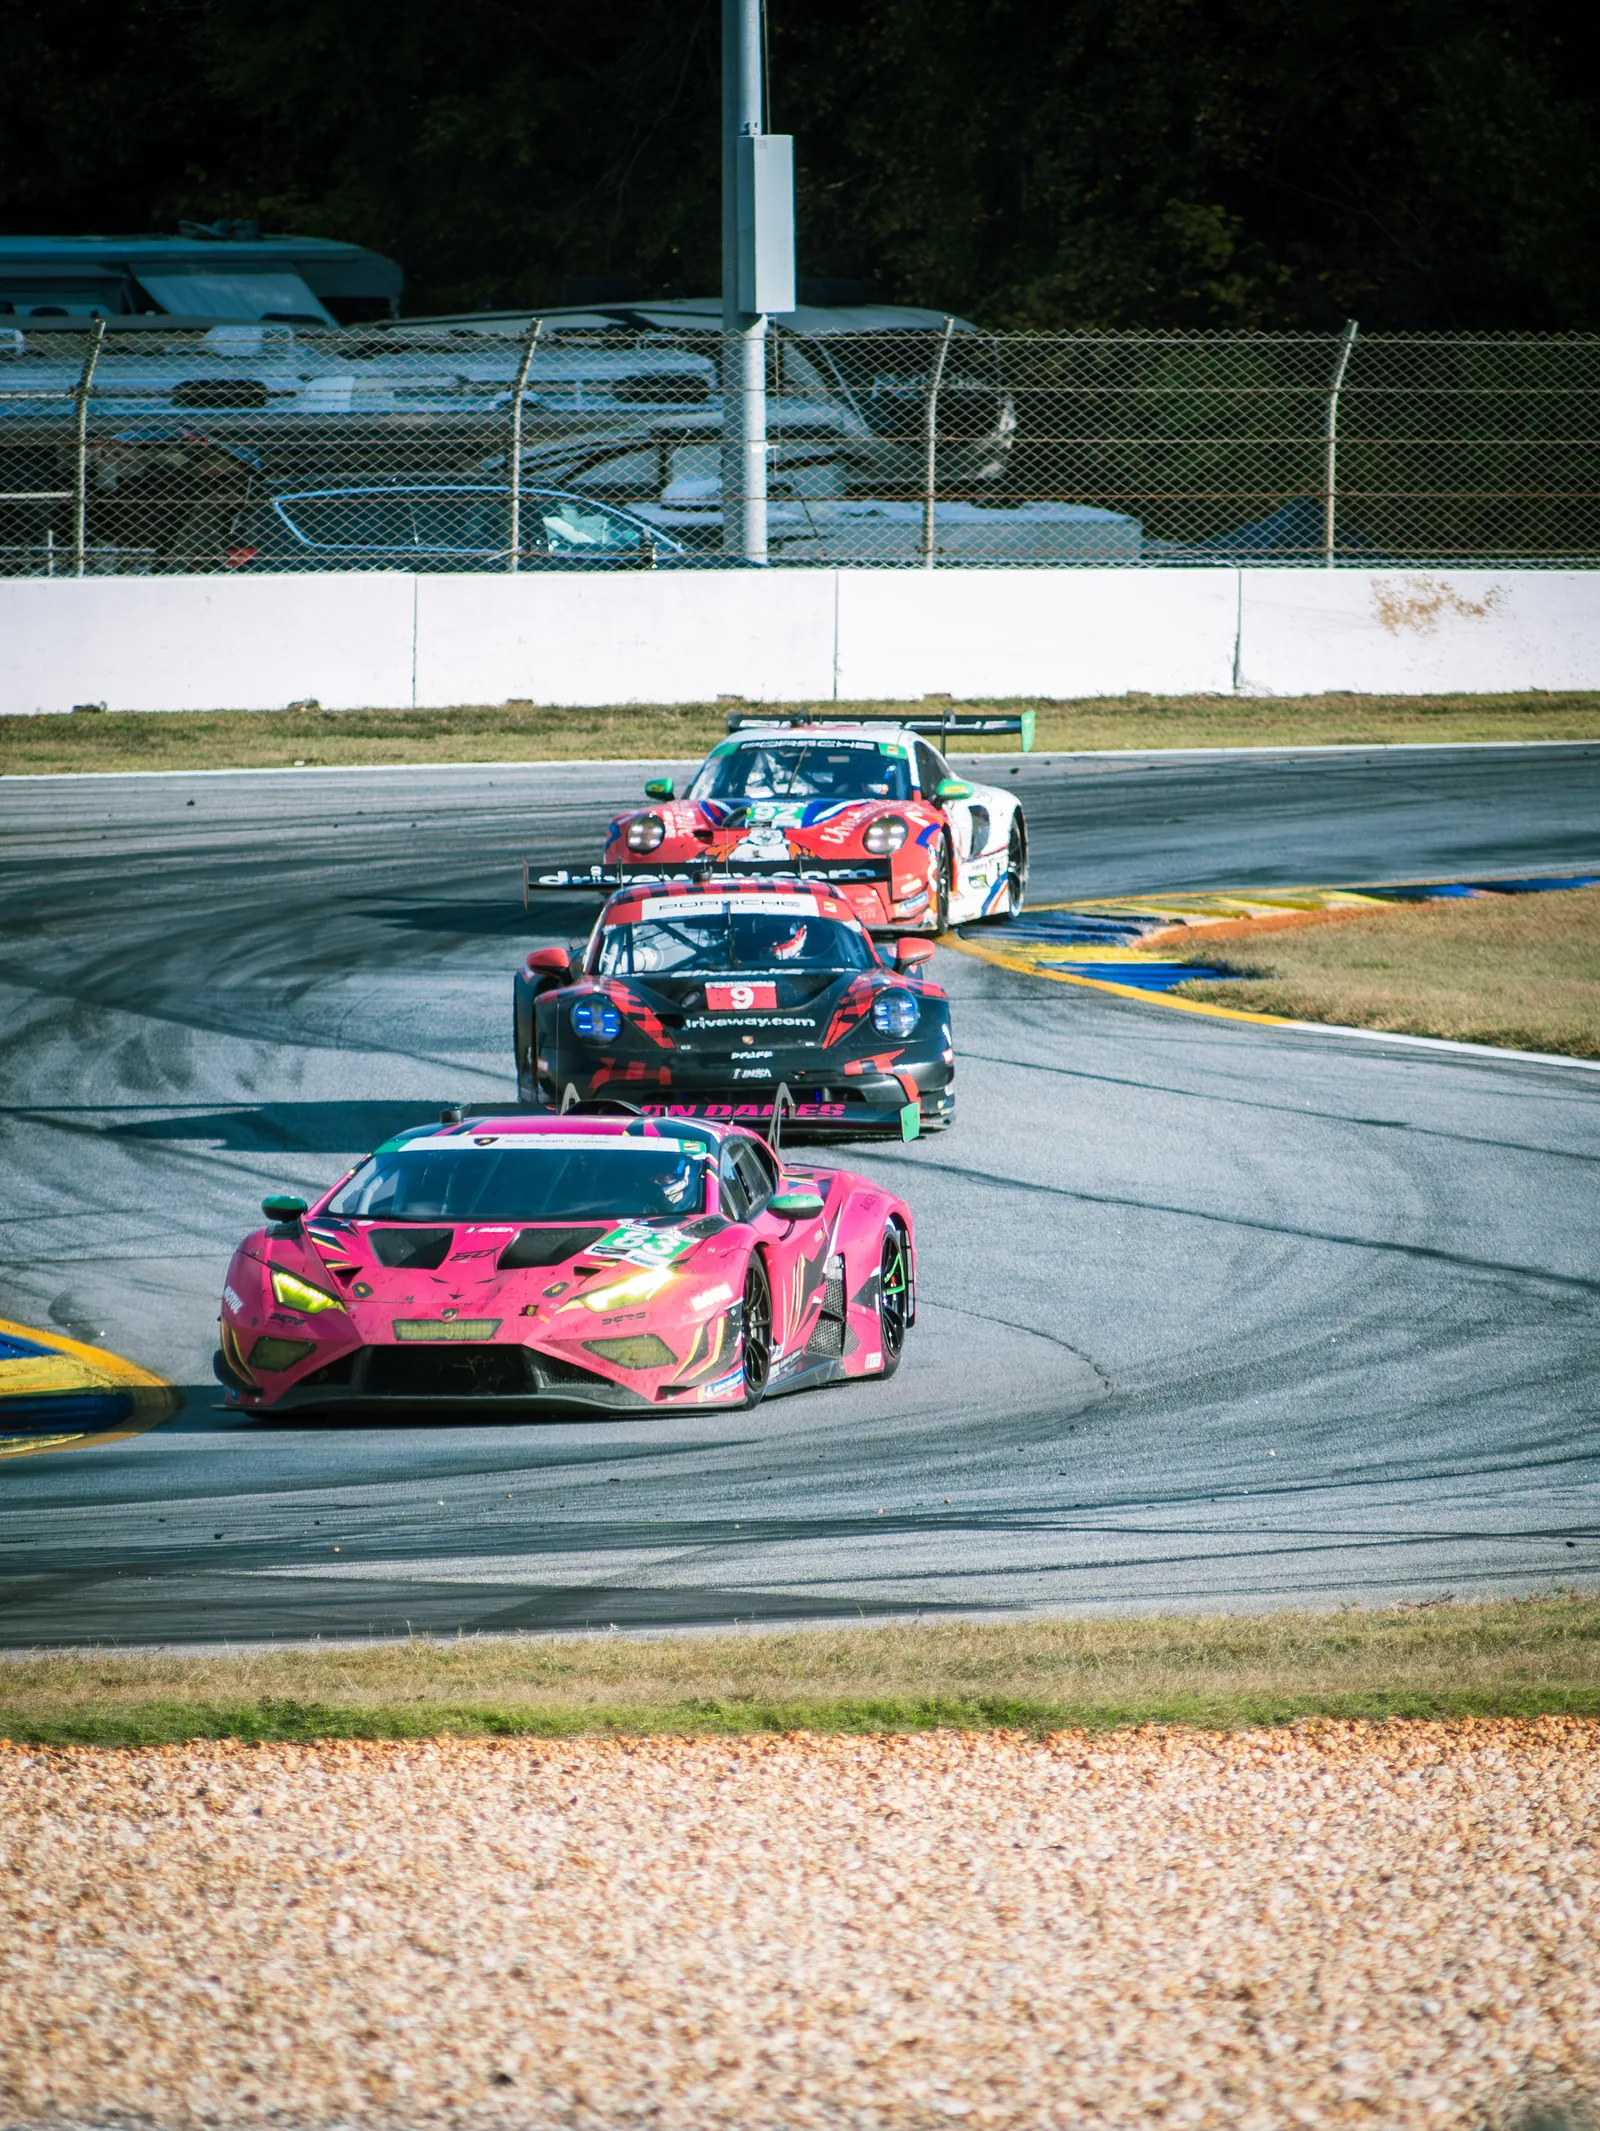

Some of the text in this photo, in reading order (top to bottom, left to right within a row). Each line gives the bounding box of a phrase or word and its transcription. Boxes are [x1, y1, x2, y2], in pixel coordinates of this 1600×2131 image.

[754, 806, 798, 821] 92
[730, 986, 754, 1010] 9
[611, 1231, 681, 1257] 83
